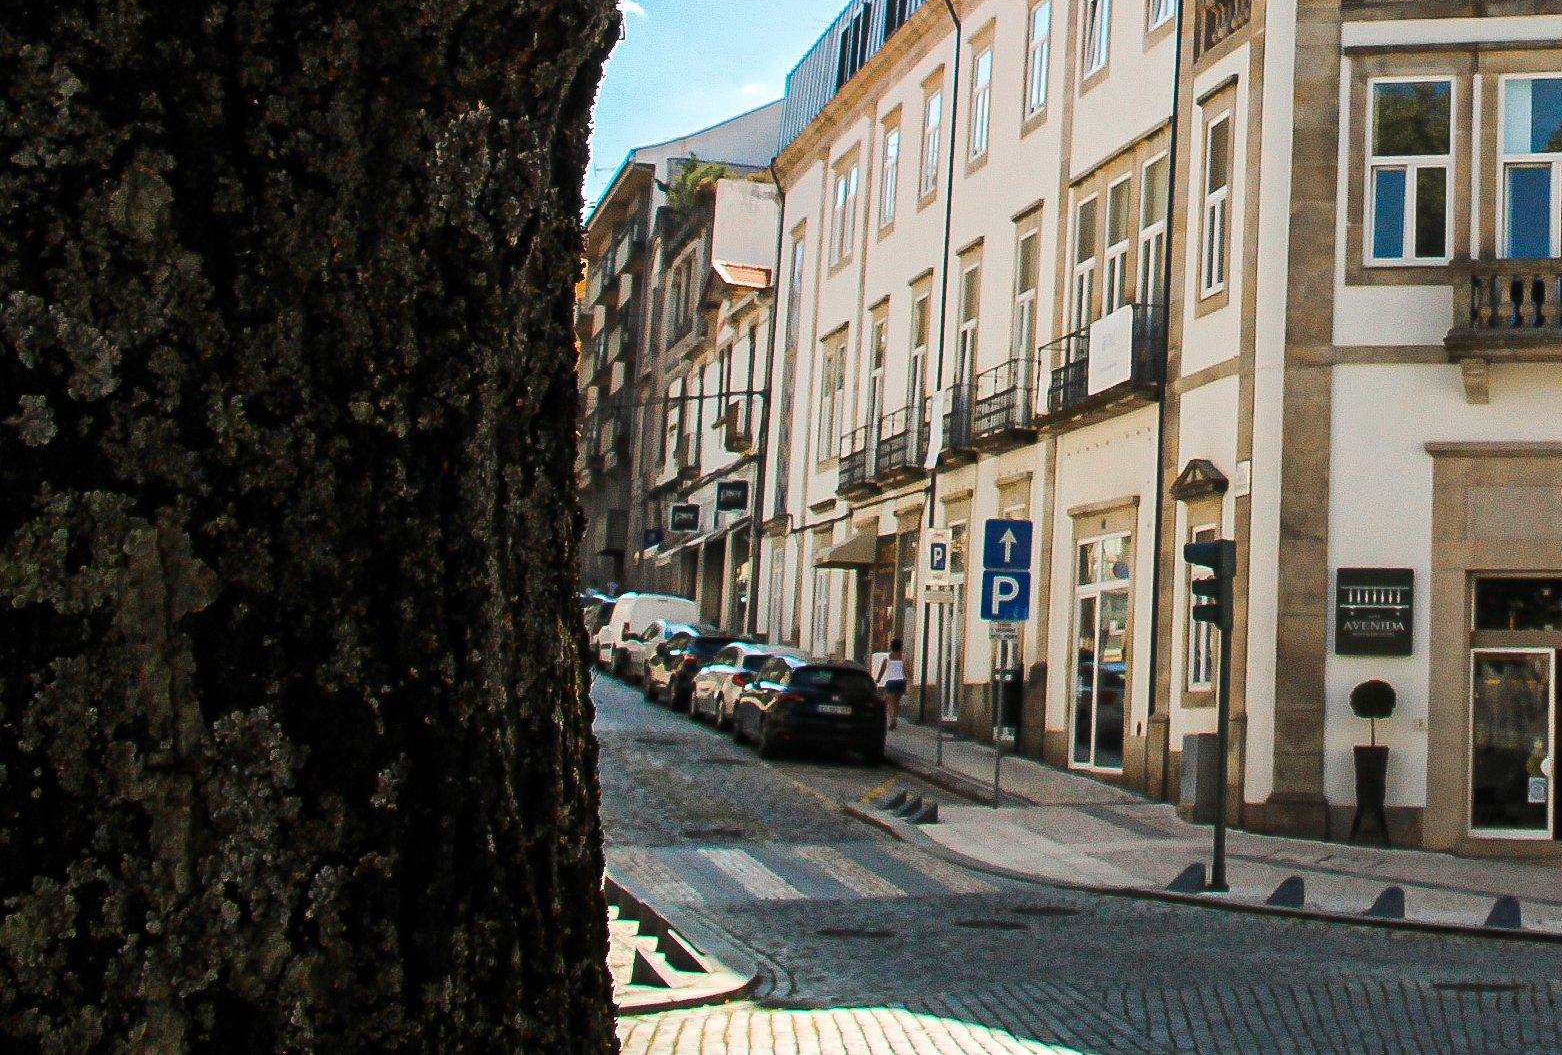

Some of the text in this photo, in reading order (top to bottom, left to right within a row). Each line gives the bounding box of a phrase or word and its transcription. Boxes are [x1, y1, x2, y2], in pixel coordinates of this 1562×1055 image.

[933, 547, 944, 567] P
[991, 575, 1020, 615] P
[1343, 620, 1405, 632] AVENIDA
